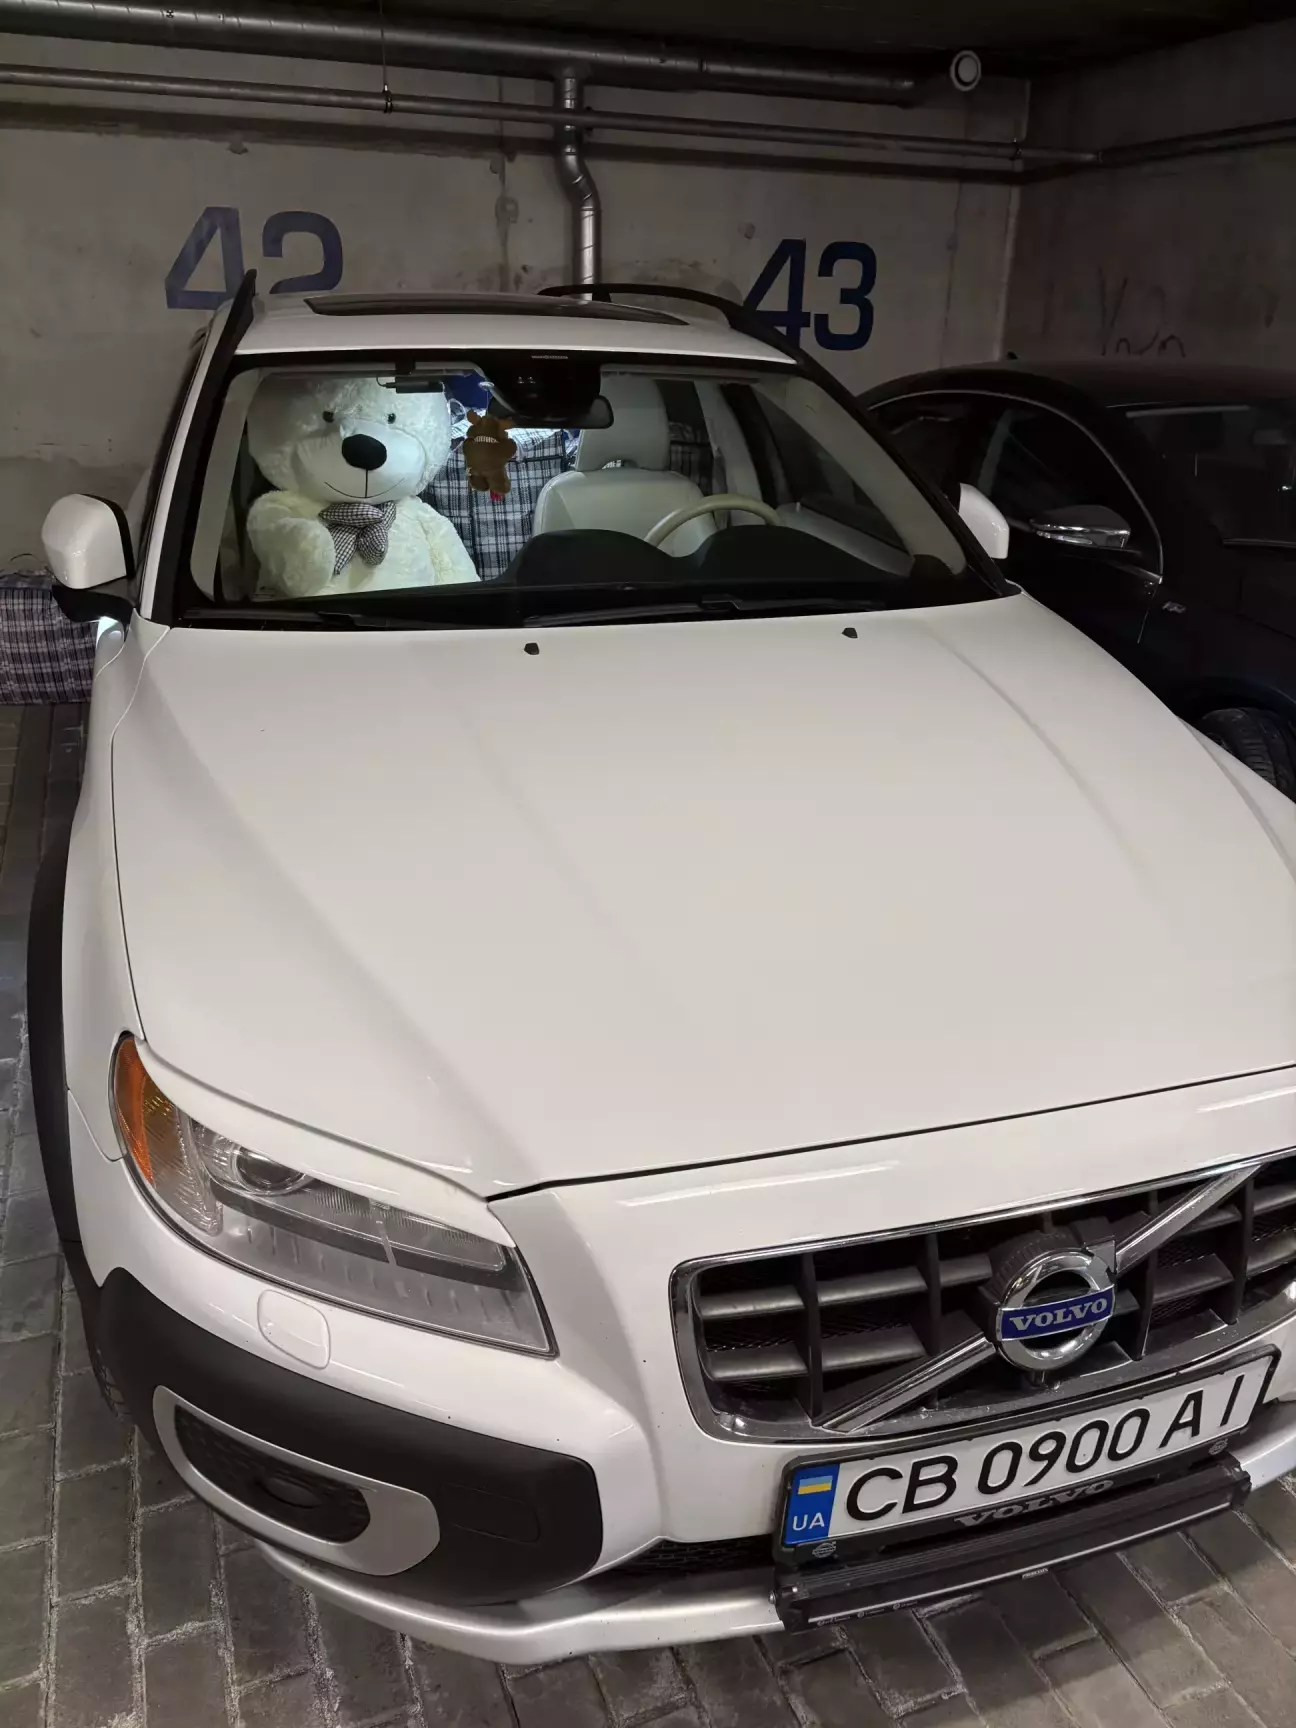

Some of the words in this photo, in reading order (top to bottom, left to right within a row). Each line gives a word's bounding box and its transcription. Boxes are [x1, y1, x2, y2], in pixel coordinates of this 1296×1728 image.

[165, 206, 343, 310] 42
[742, 238, 877, 350] 43
[1008, 1298, 1108, 1331] VOLVO
[846, 1455, 958, 1521] CB
[977, 1408, 1151, 1495] 0900
[792, 1512, 825, 1531] UA
[954, 1480, 1114, 1527] VOLVO
